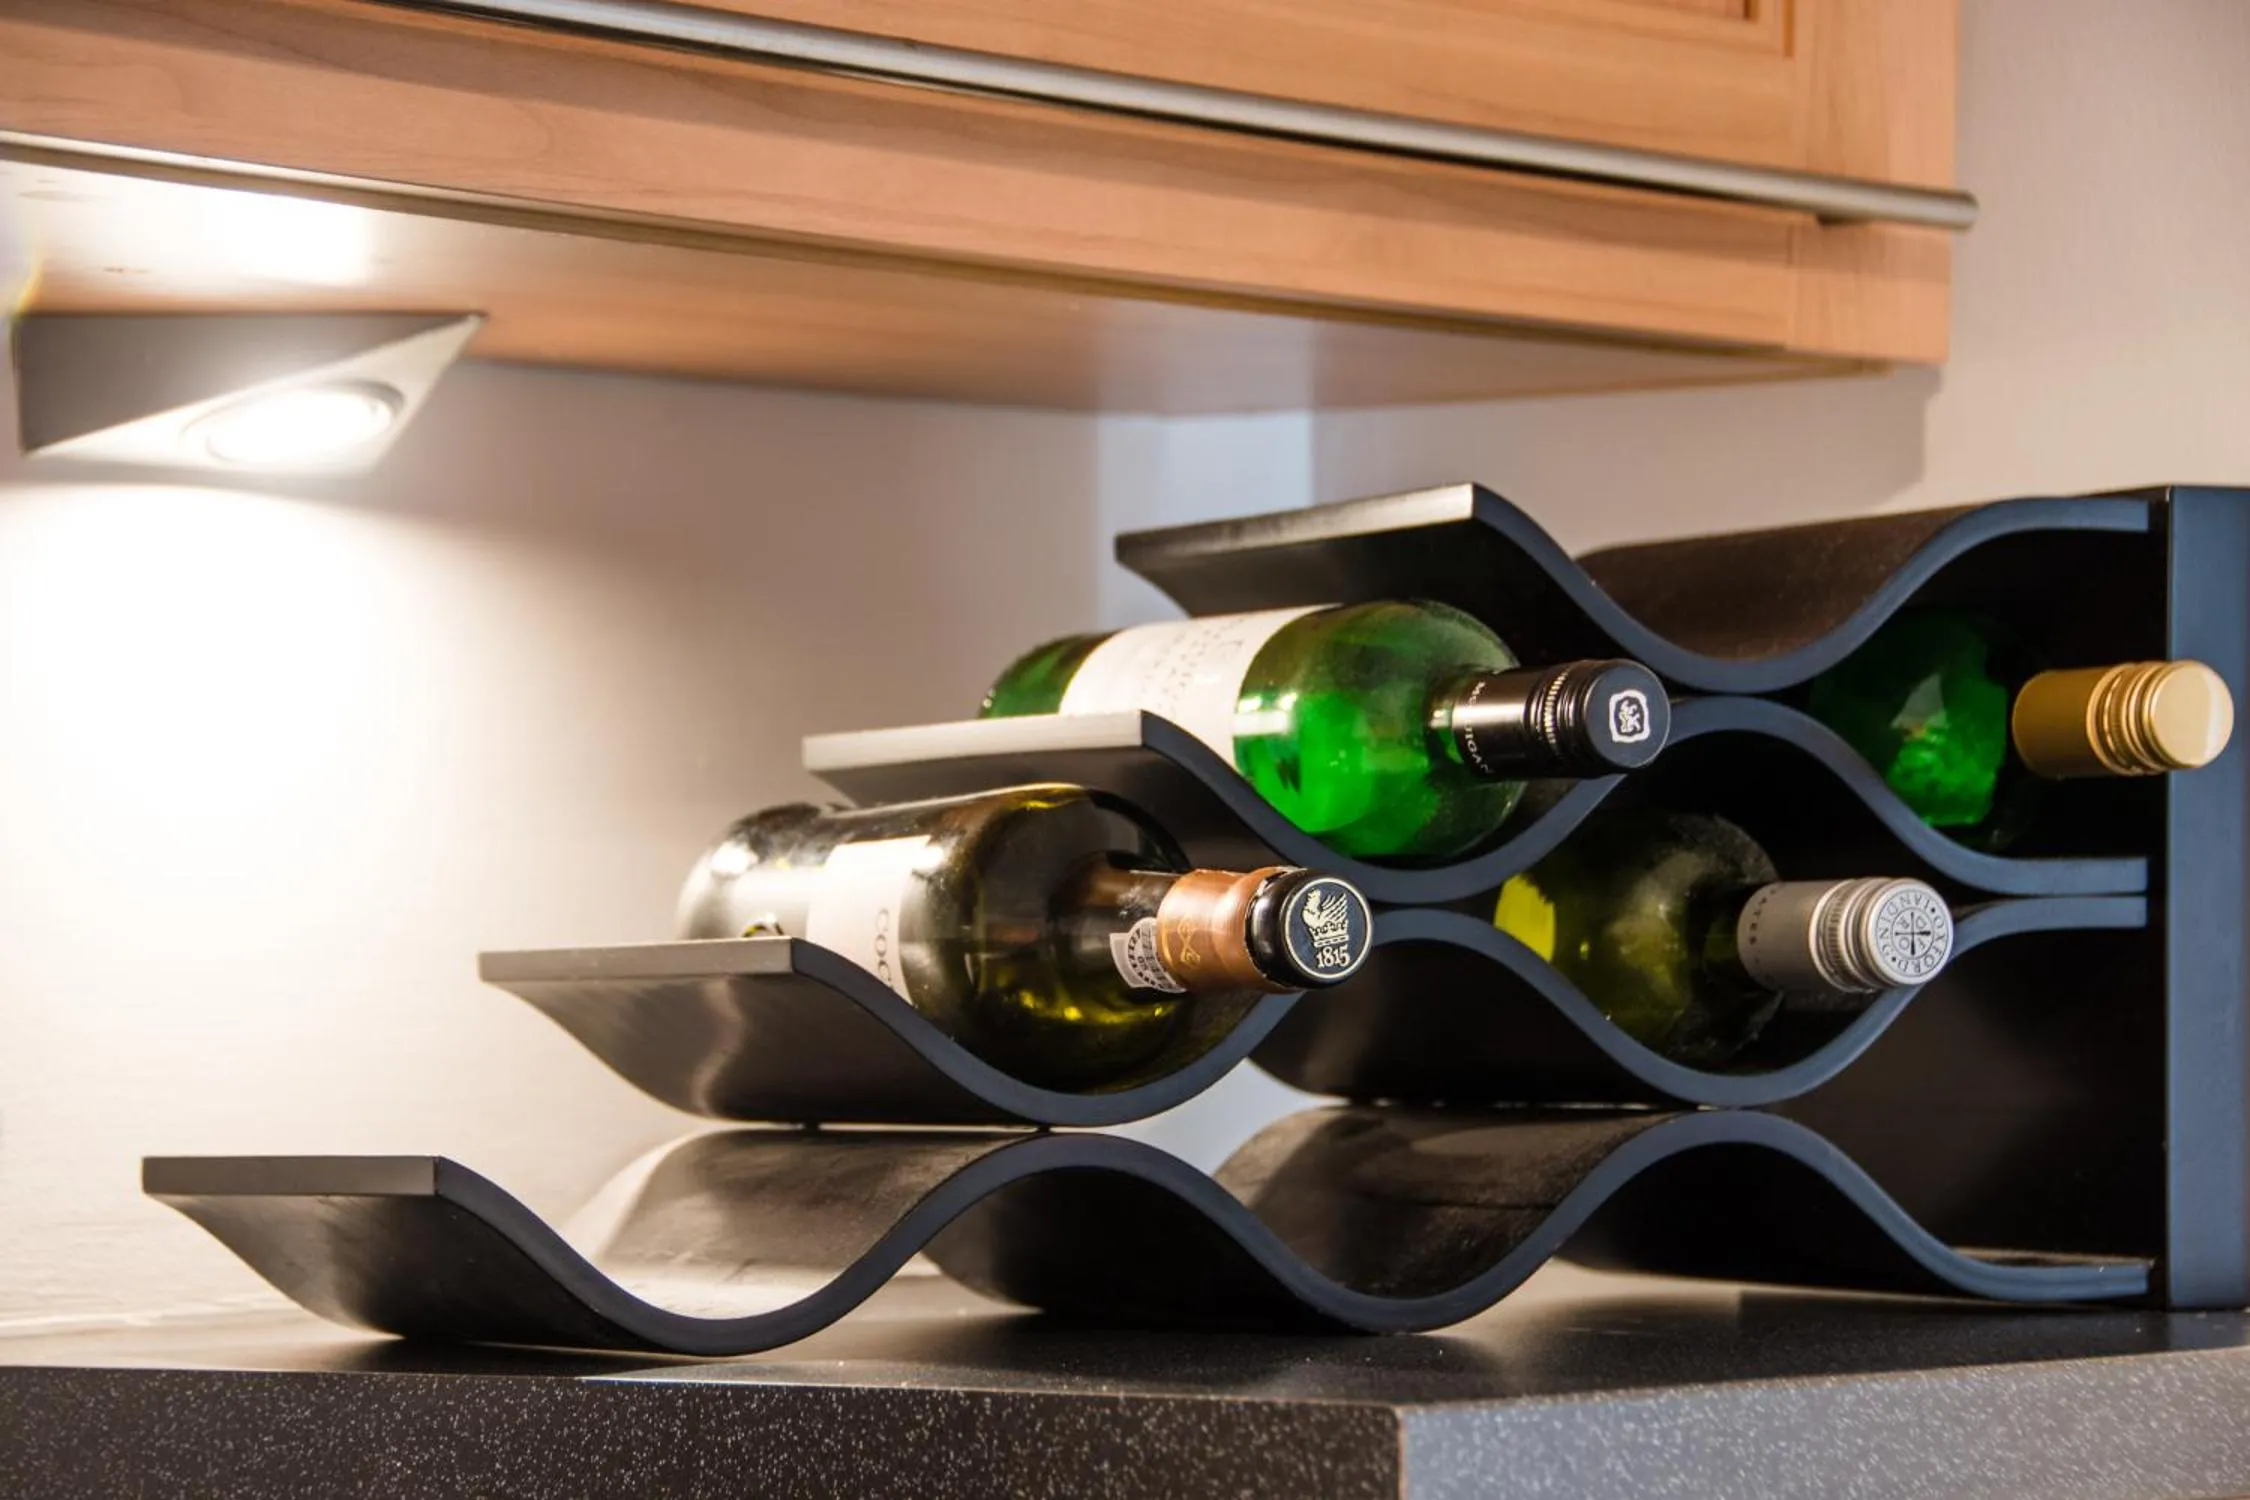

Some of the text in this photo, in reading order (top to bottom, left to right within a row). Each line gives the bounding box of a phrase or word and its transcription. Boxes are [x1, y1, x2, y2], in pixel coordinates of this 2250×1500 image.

[875, 908, 893, 989] COC
[1316, 944, 1350, 968] 1815
[1879, 892, 1946, 973] OXFORD LANDING
